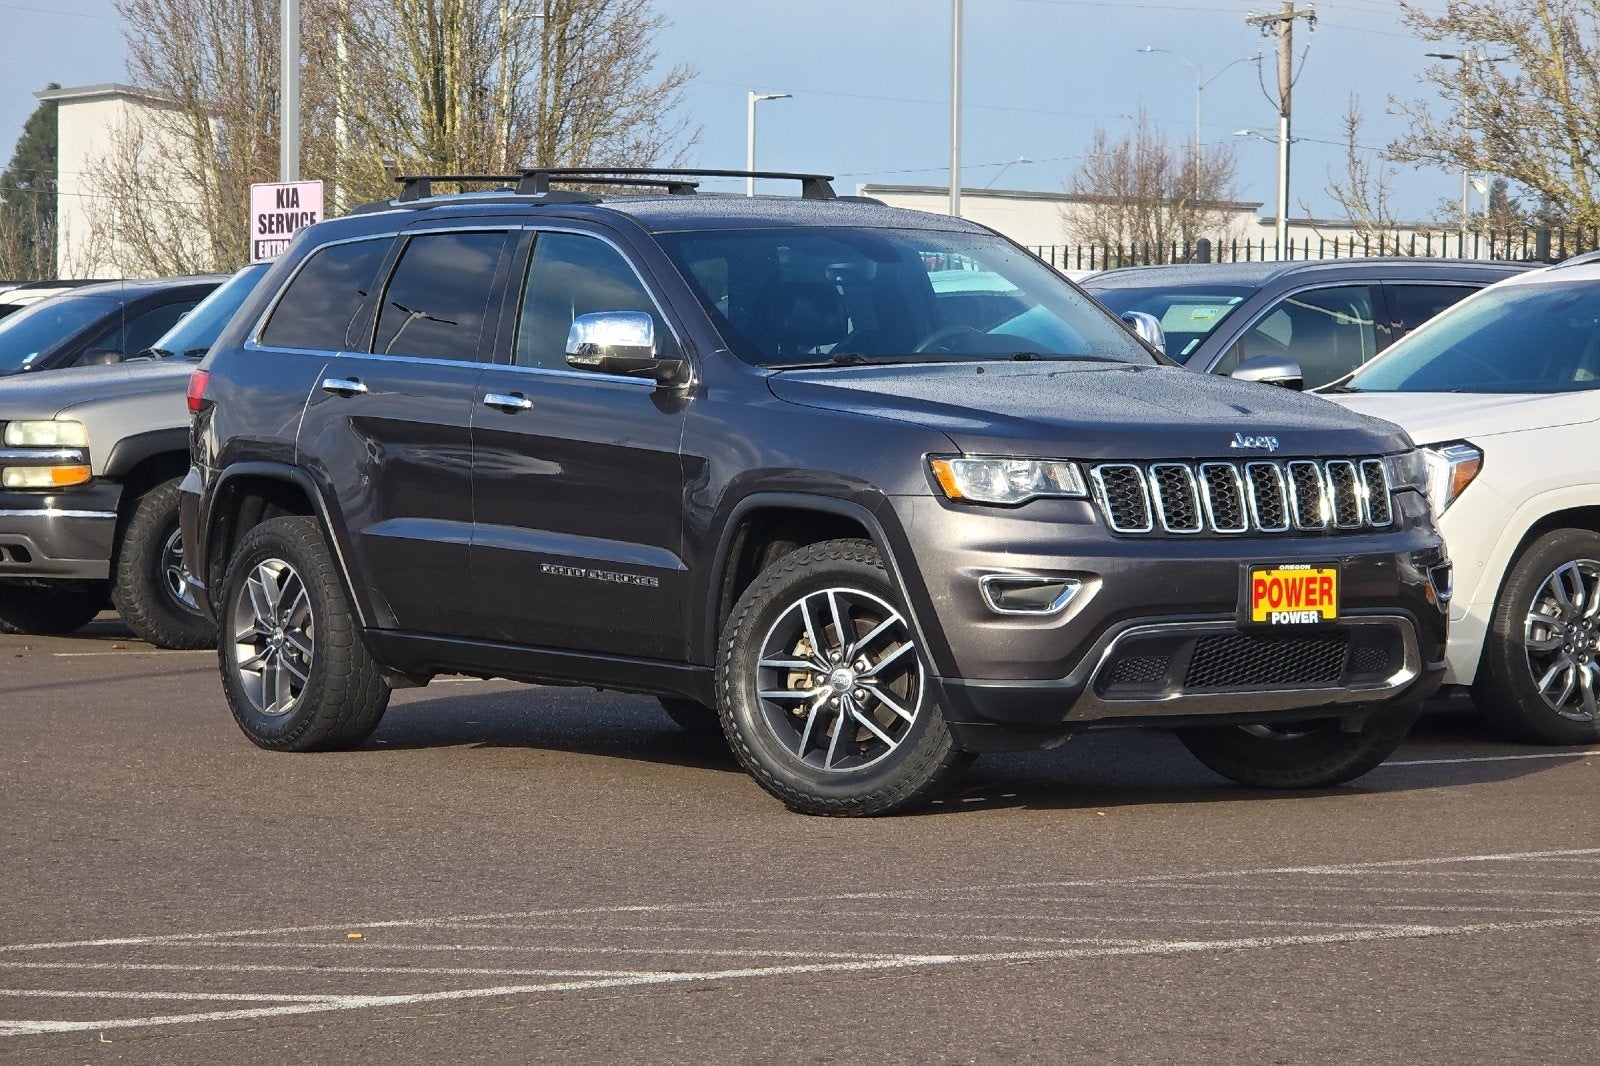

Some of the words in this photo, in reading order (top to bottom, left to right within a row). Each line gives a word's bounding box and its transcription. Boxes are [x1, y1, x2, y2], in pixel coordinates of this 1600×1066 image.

[276, 187, 300, 209] KIA
[258, 211, 317, 234] SERVICE
[1230, 432, 1279, 453] Jeep
[1253, 576, 1333, 609] POWER
[1271, 610, 1319, 625] POWER
